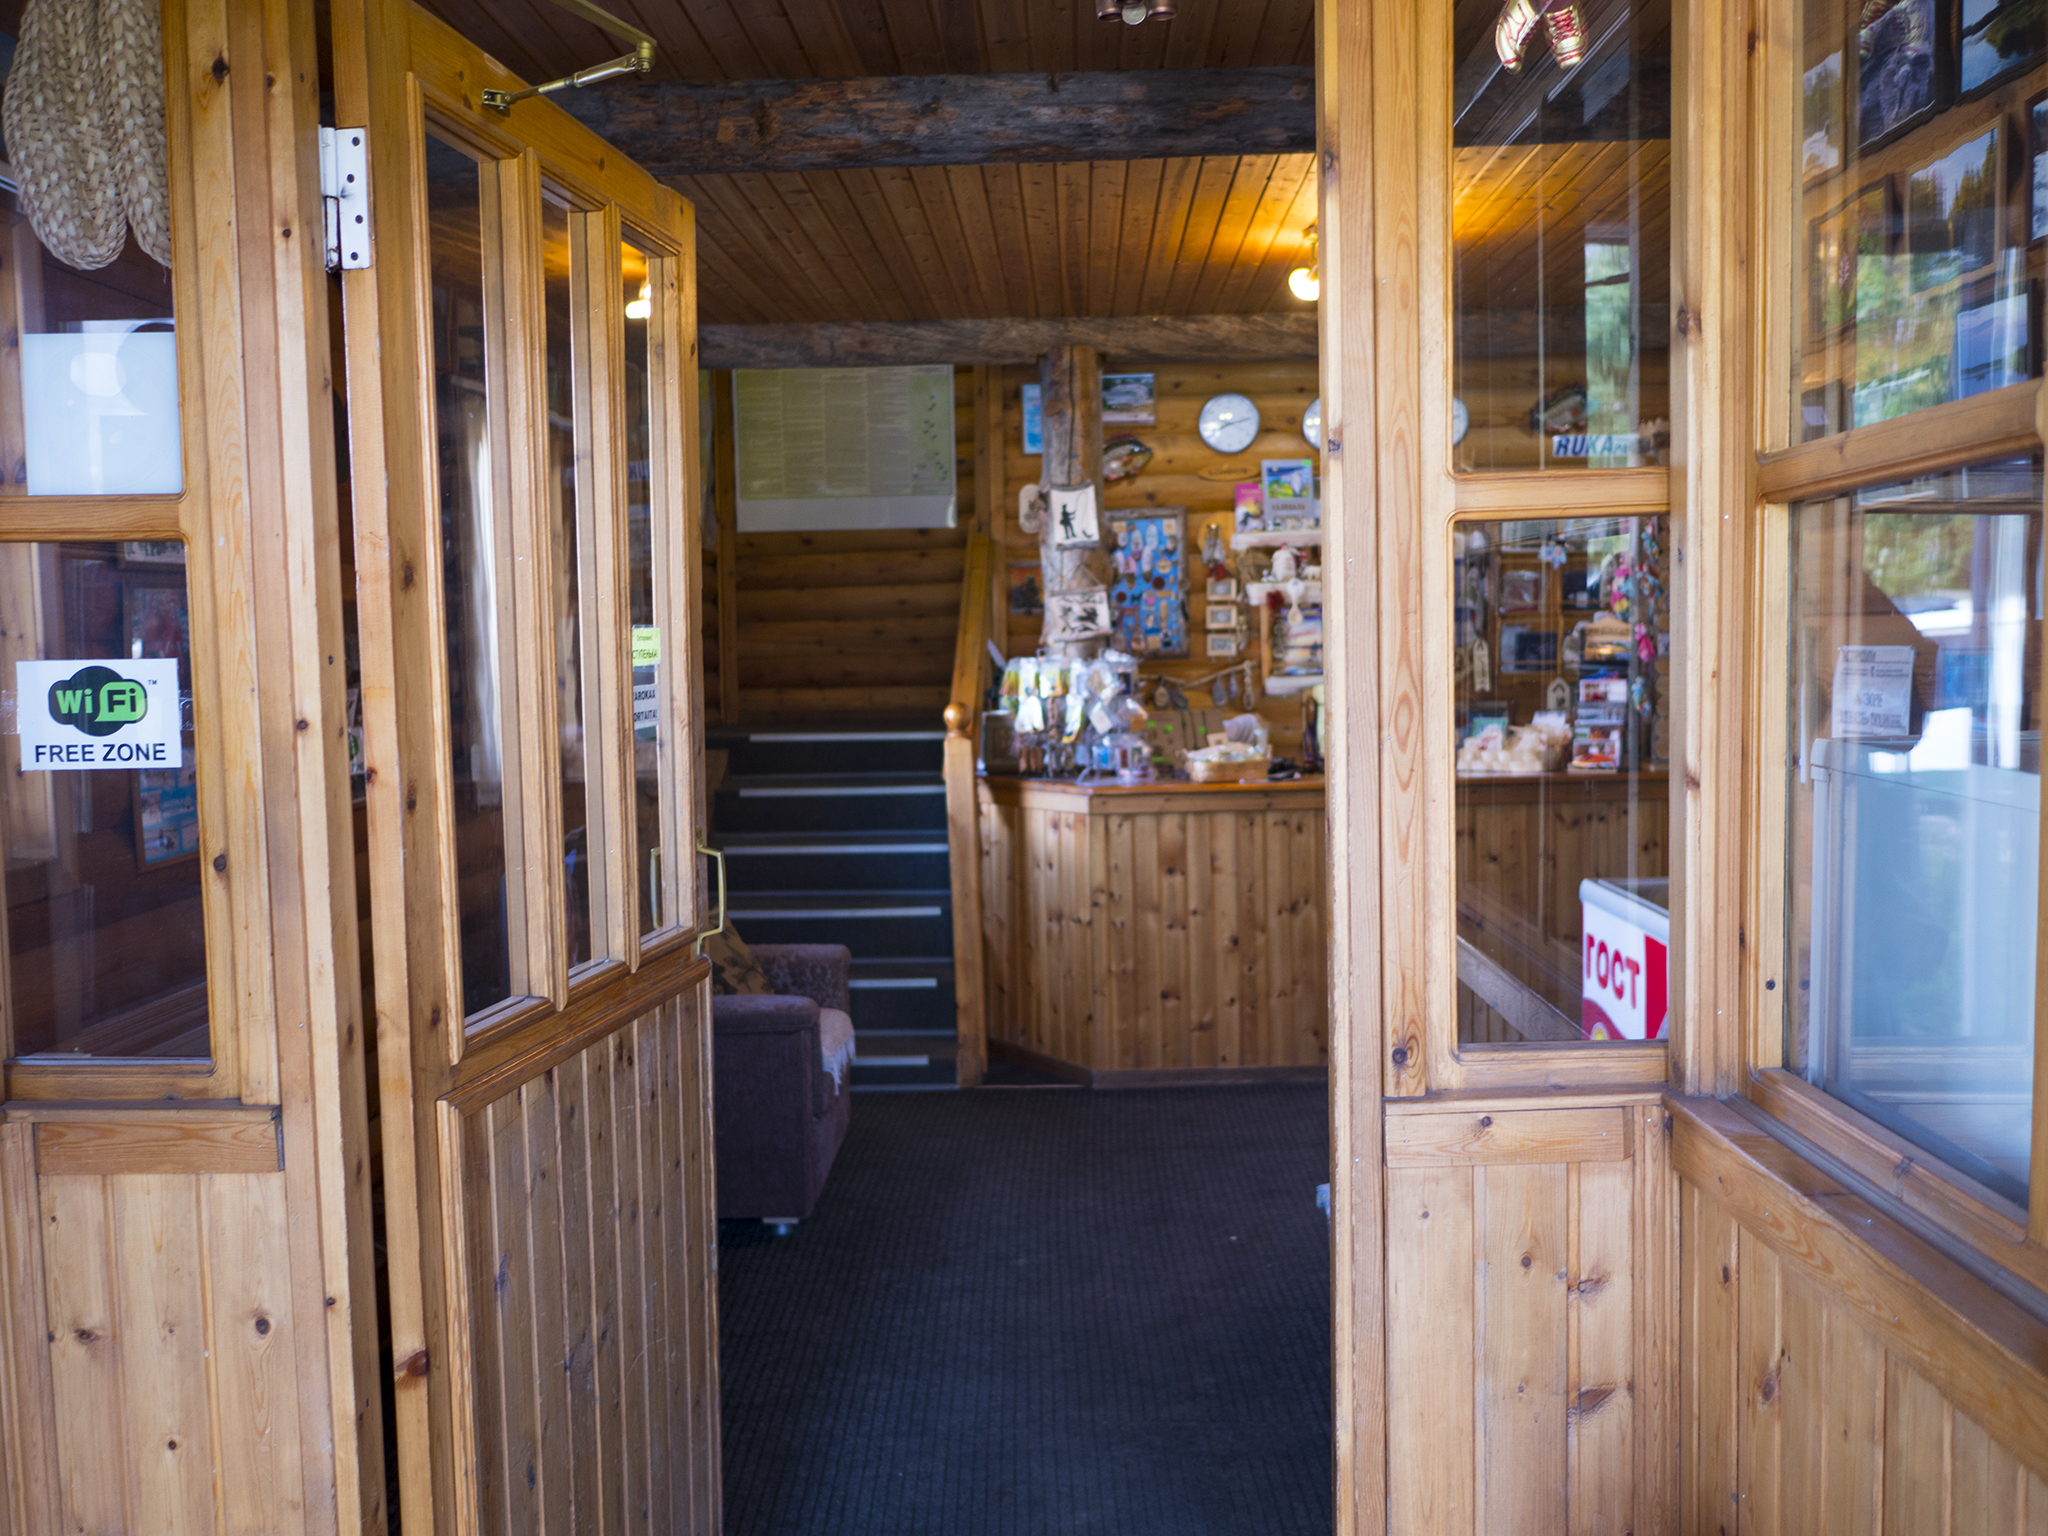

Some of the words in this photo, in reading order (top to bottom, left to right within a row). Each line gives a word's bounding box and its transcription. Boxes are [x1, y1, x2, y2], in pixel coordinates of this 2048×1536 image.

[633, 689, 656, 701] AROKAA
[633, 709, 658, 722] ORTAITA!
[35, 744, 95, 763] FREE
[102, 743, 167, 762] ZONE
